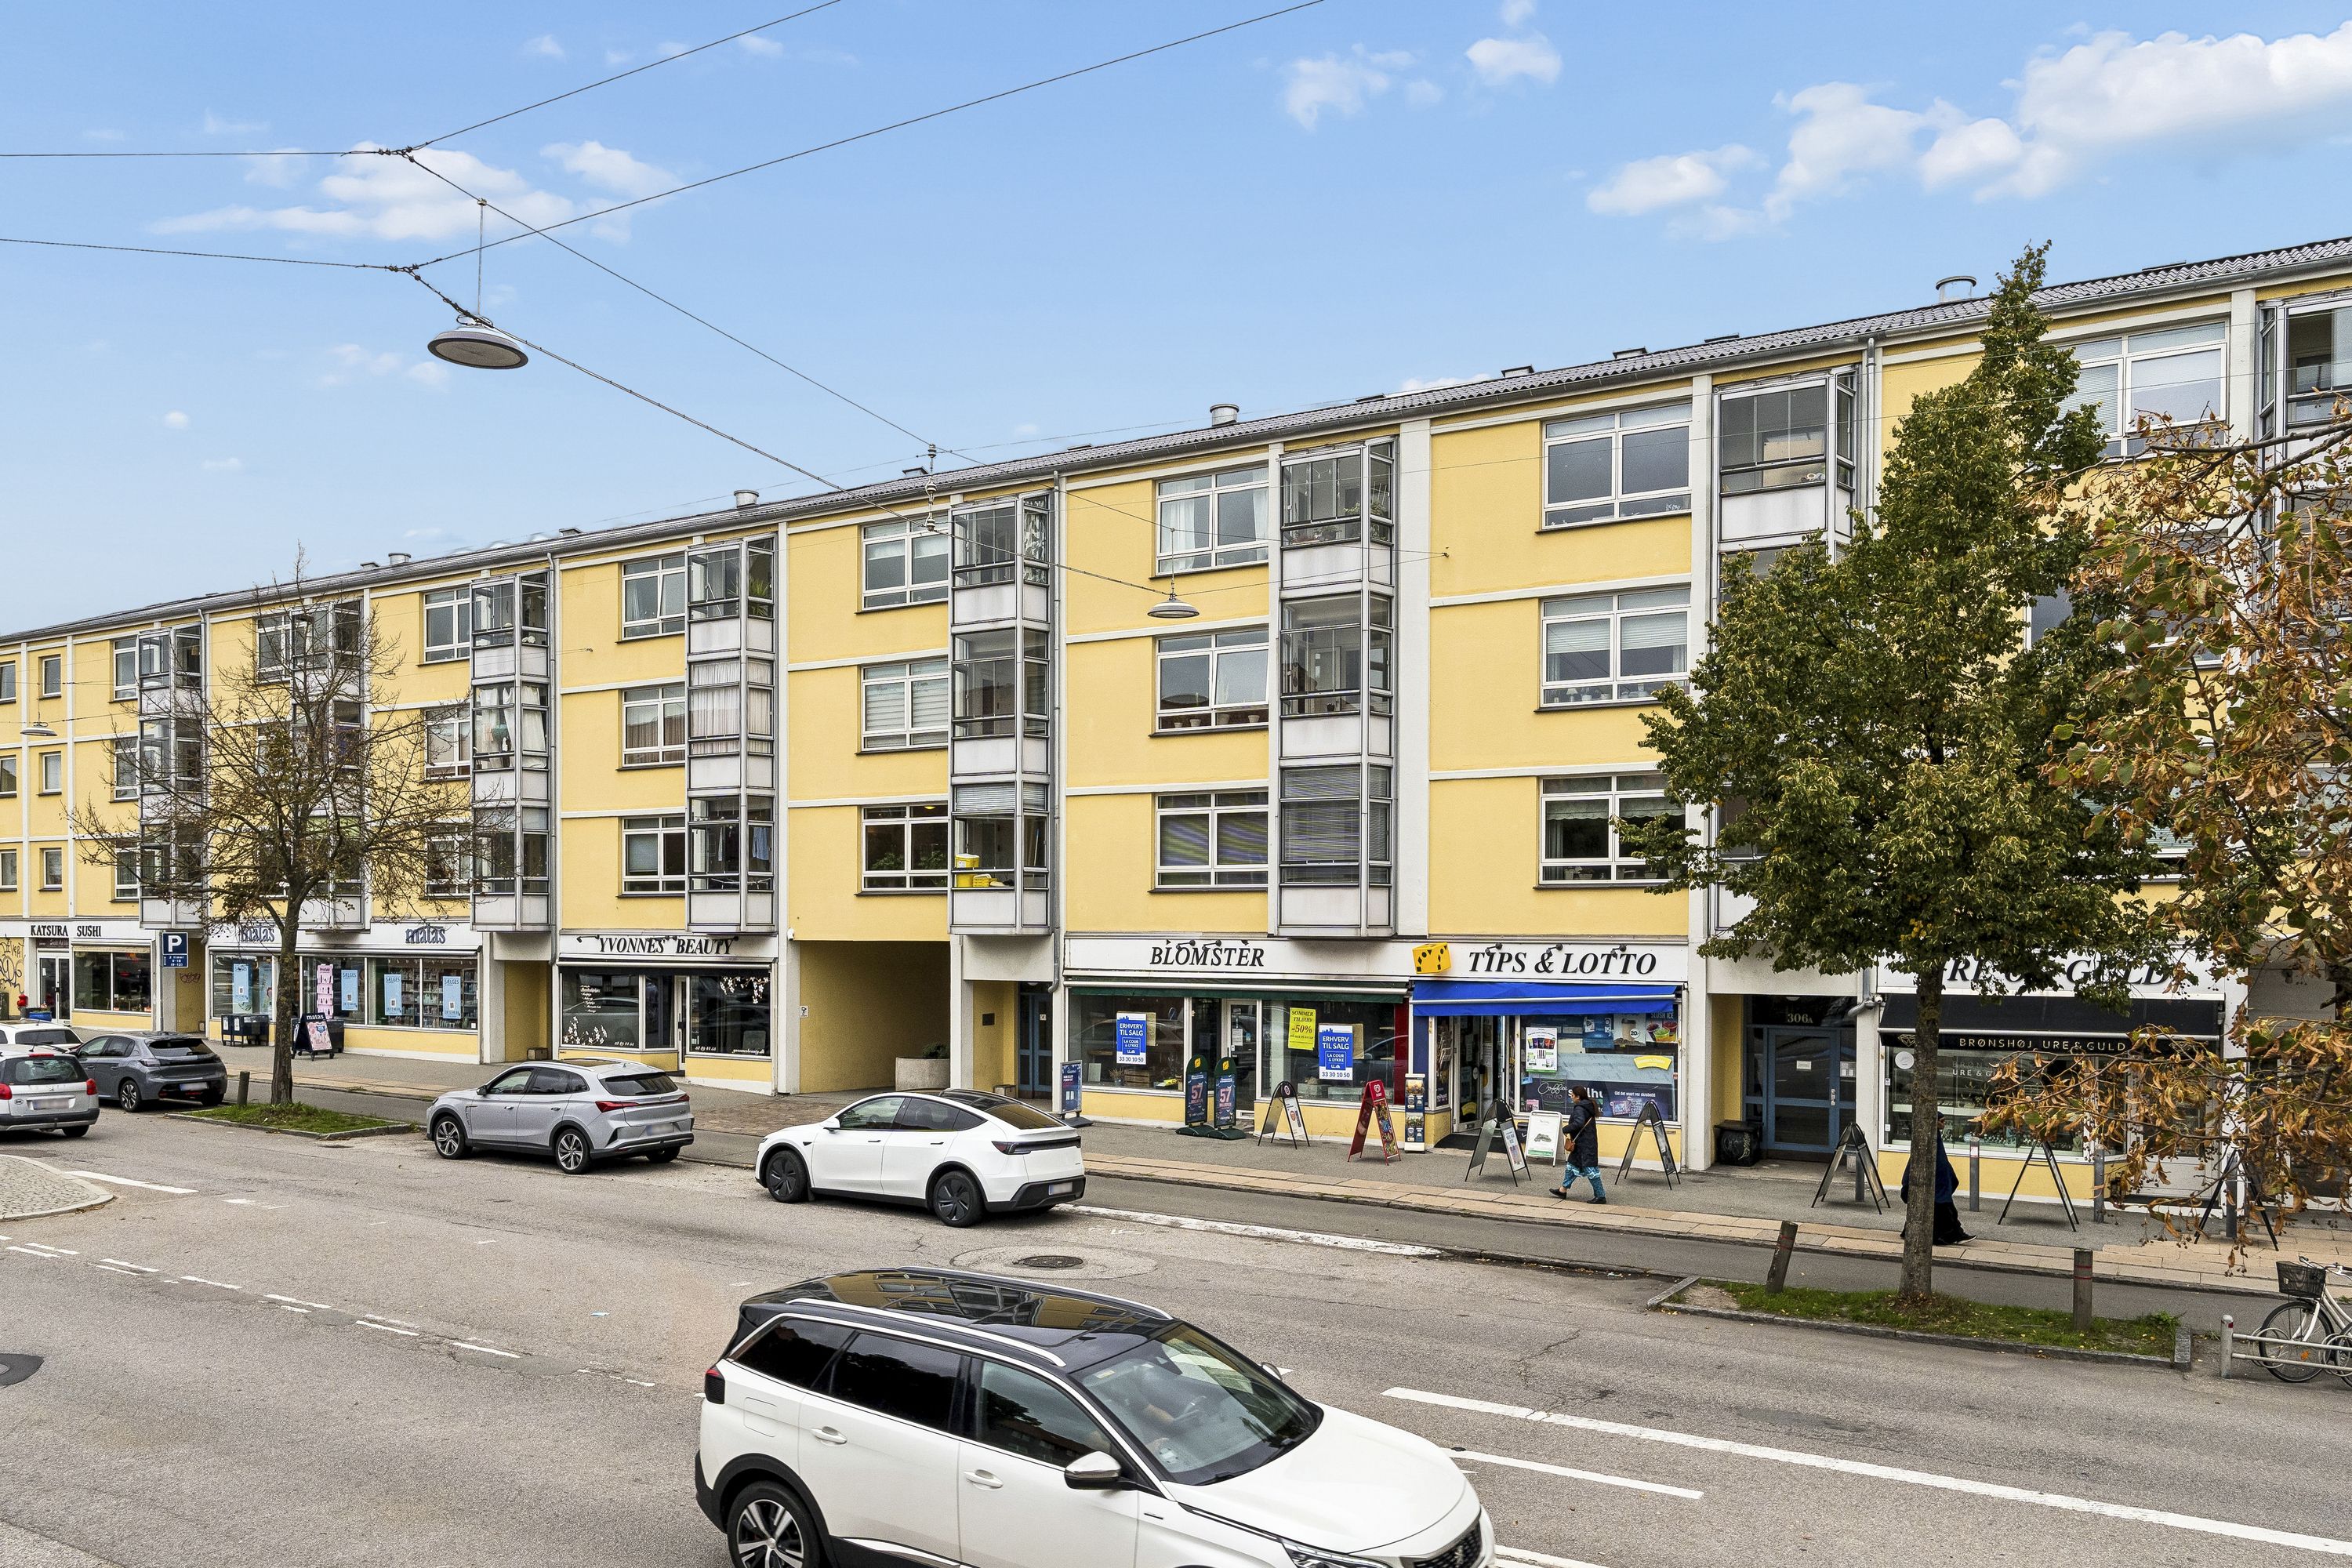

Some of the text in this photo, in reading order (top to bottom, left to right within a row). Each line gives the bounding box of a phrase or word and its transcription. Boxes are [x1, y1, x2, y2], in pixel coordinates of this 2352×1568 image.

[31, 925, 102, 937] KATSURA SUSHI
[405, 925, 446, 944] matas
[168, 935, 182, 953] P
[598, 937, 734, 955] YVONNES BEAUTY
[1149, 946, 1265, 967] BLOMSTER
[1468, 951, 1657, 975] TIPS & LOTTO
[1788, 1013, 1813, 1024] 306A
[1291, 1024, 1312, 1034] -50%
[1959, 1038, 2032, 1048] BRØNSHØJ
[2042, 1040, 2069, 1050] URE
[2086, 1041, 2125, 1051] GULD
[1191, 1083, 1203, 1100] 57
[1219, 1087, 1232, 1103] 57
[1537, 1082, 1568, 1094] Coffee
